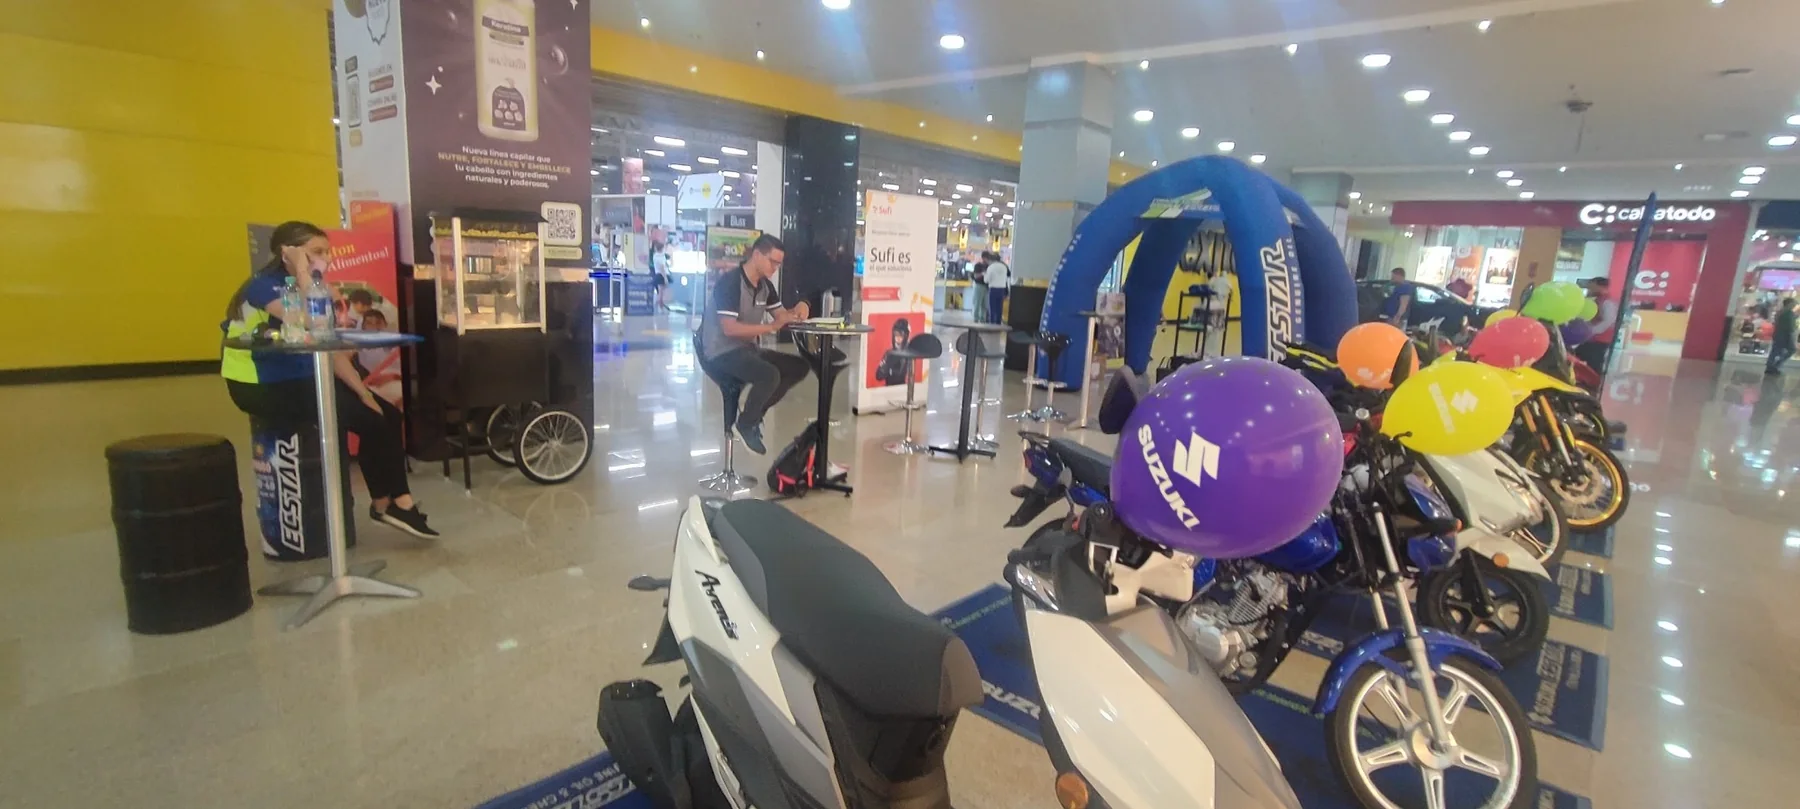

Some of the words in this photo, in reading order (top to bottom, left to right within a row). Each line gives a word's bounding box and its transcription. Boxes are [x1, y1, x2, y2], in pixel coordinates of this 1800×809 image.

[462, 145, 488, 156] Nueva
[510, 153, 535, 162] capilar
[455, 163, 464, 171] tu
[466, 165, 495, 174] cabello
[513, 170, 557, 181] ingredientes
[472, 155, 519, 168] FORTALECE
[527, 162, 571, 174] EMBELLECE
[465, 174, 502, 184] naturales
[879, 205, 892, 215] Sufi
[870, 246, 896, 263] Sufi
[898, 252, 912, 264] es
[1138, 424, 1201, 531] SUZUKI
[275, 433, 305, 554] ECSTAR
